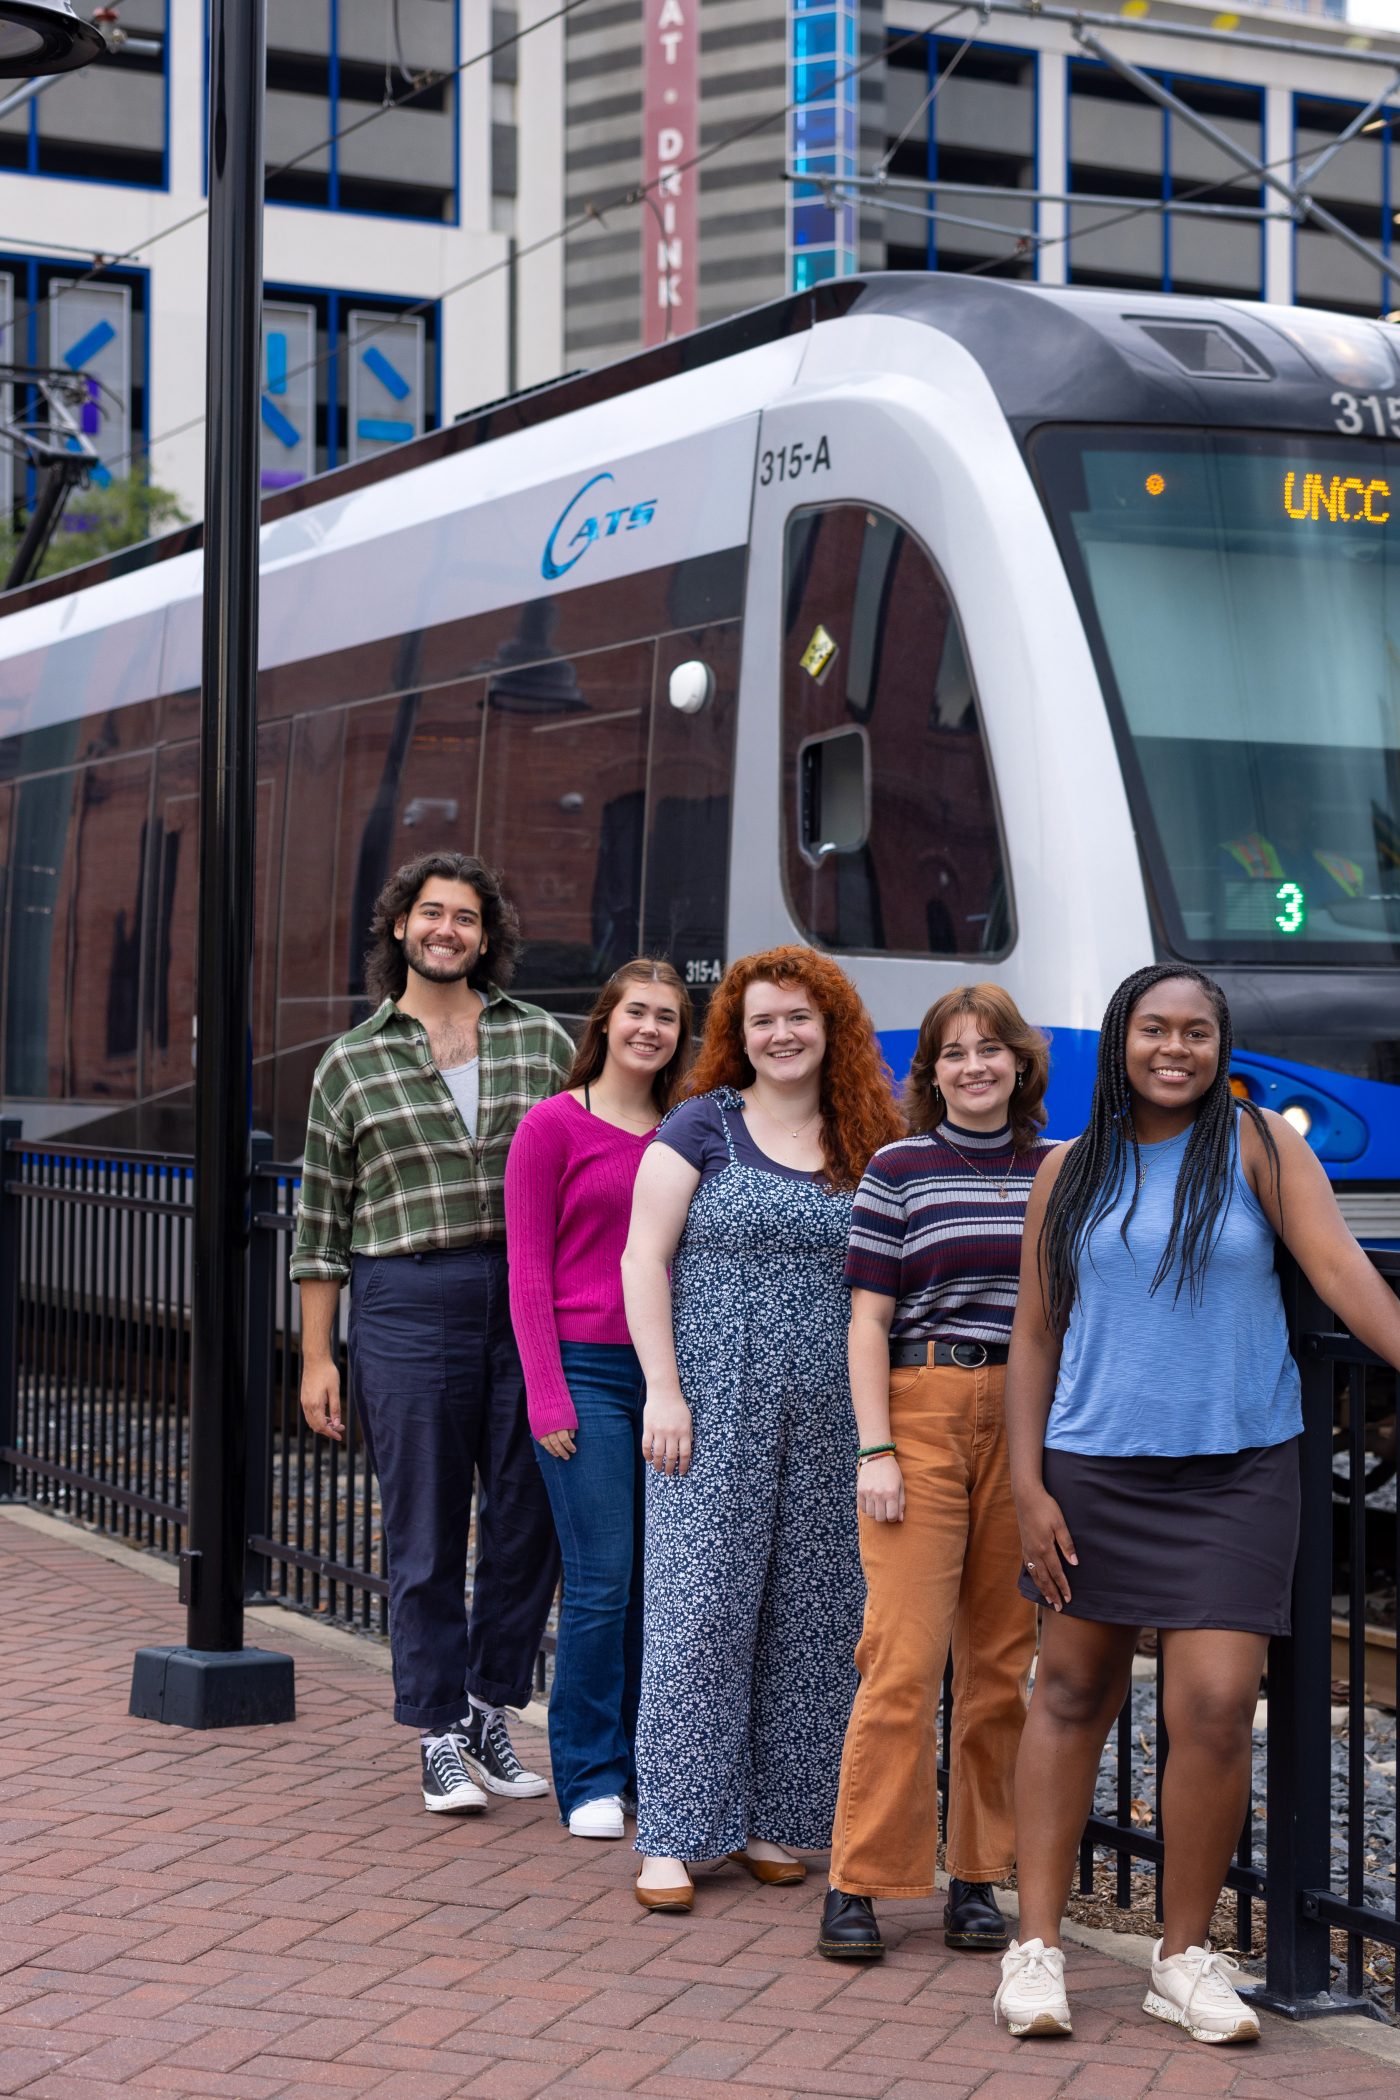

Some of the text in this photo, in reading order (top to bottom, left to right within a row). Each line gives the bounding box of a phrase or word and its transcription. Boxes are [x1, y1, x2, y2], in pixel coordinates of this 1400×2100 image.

[657, 127, 684, 309] DRINK
[760, 435, 830, 486] 315-A
[1284, 471, 1391, 524] UNCC
[541, 472, 658, 580] CATS
[1275, 882, 1304, 932] 3
[685, 958, 722, 983] 315-A
